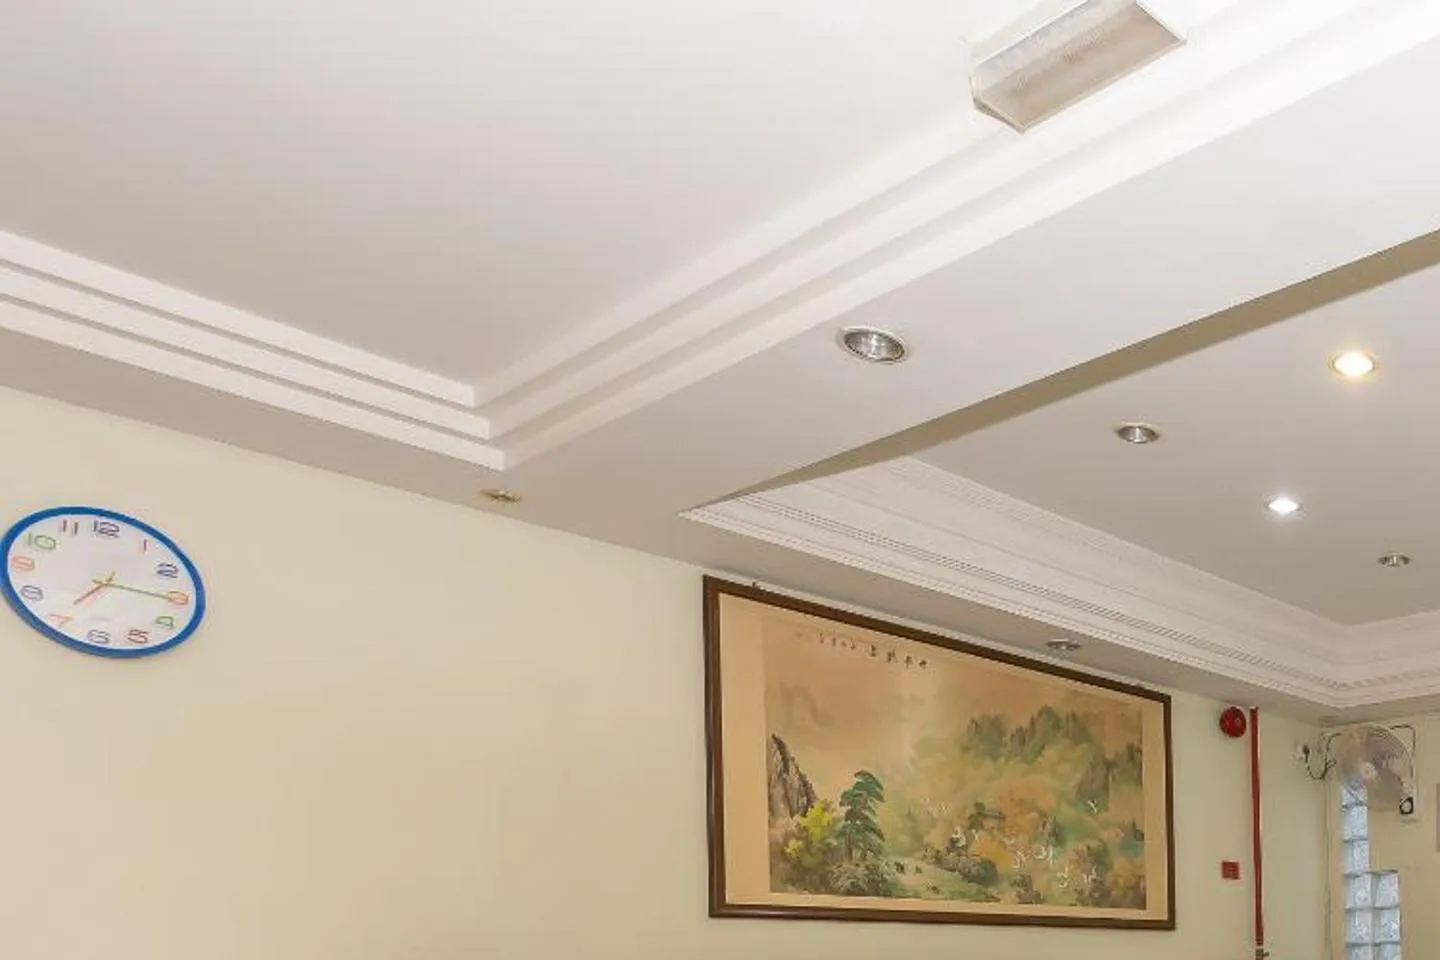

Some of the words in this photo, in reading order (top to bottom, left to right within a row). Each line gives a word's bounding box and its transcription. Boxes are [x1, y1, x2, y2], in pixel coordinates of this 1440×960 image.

[61, 519, 79, 535] 11
[93, 519, 120, 538] 12
[157, 563, 178, 579] 2
